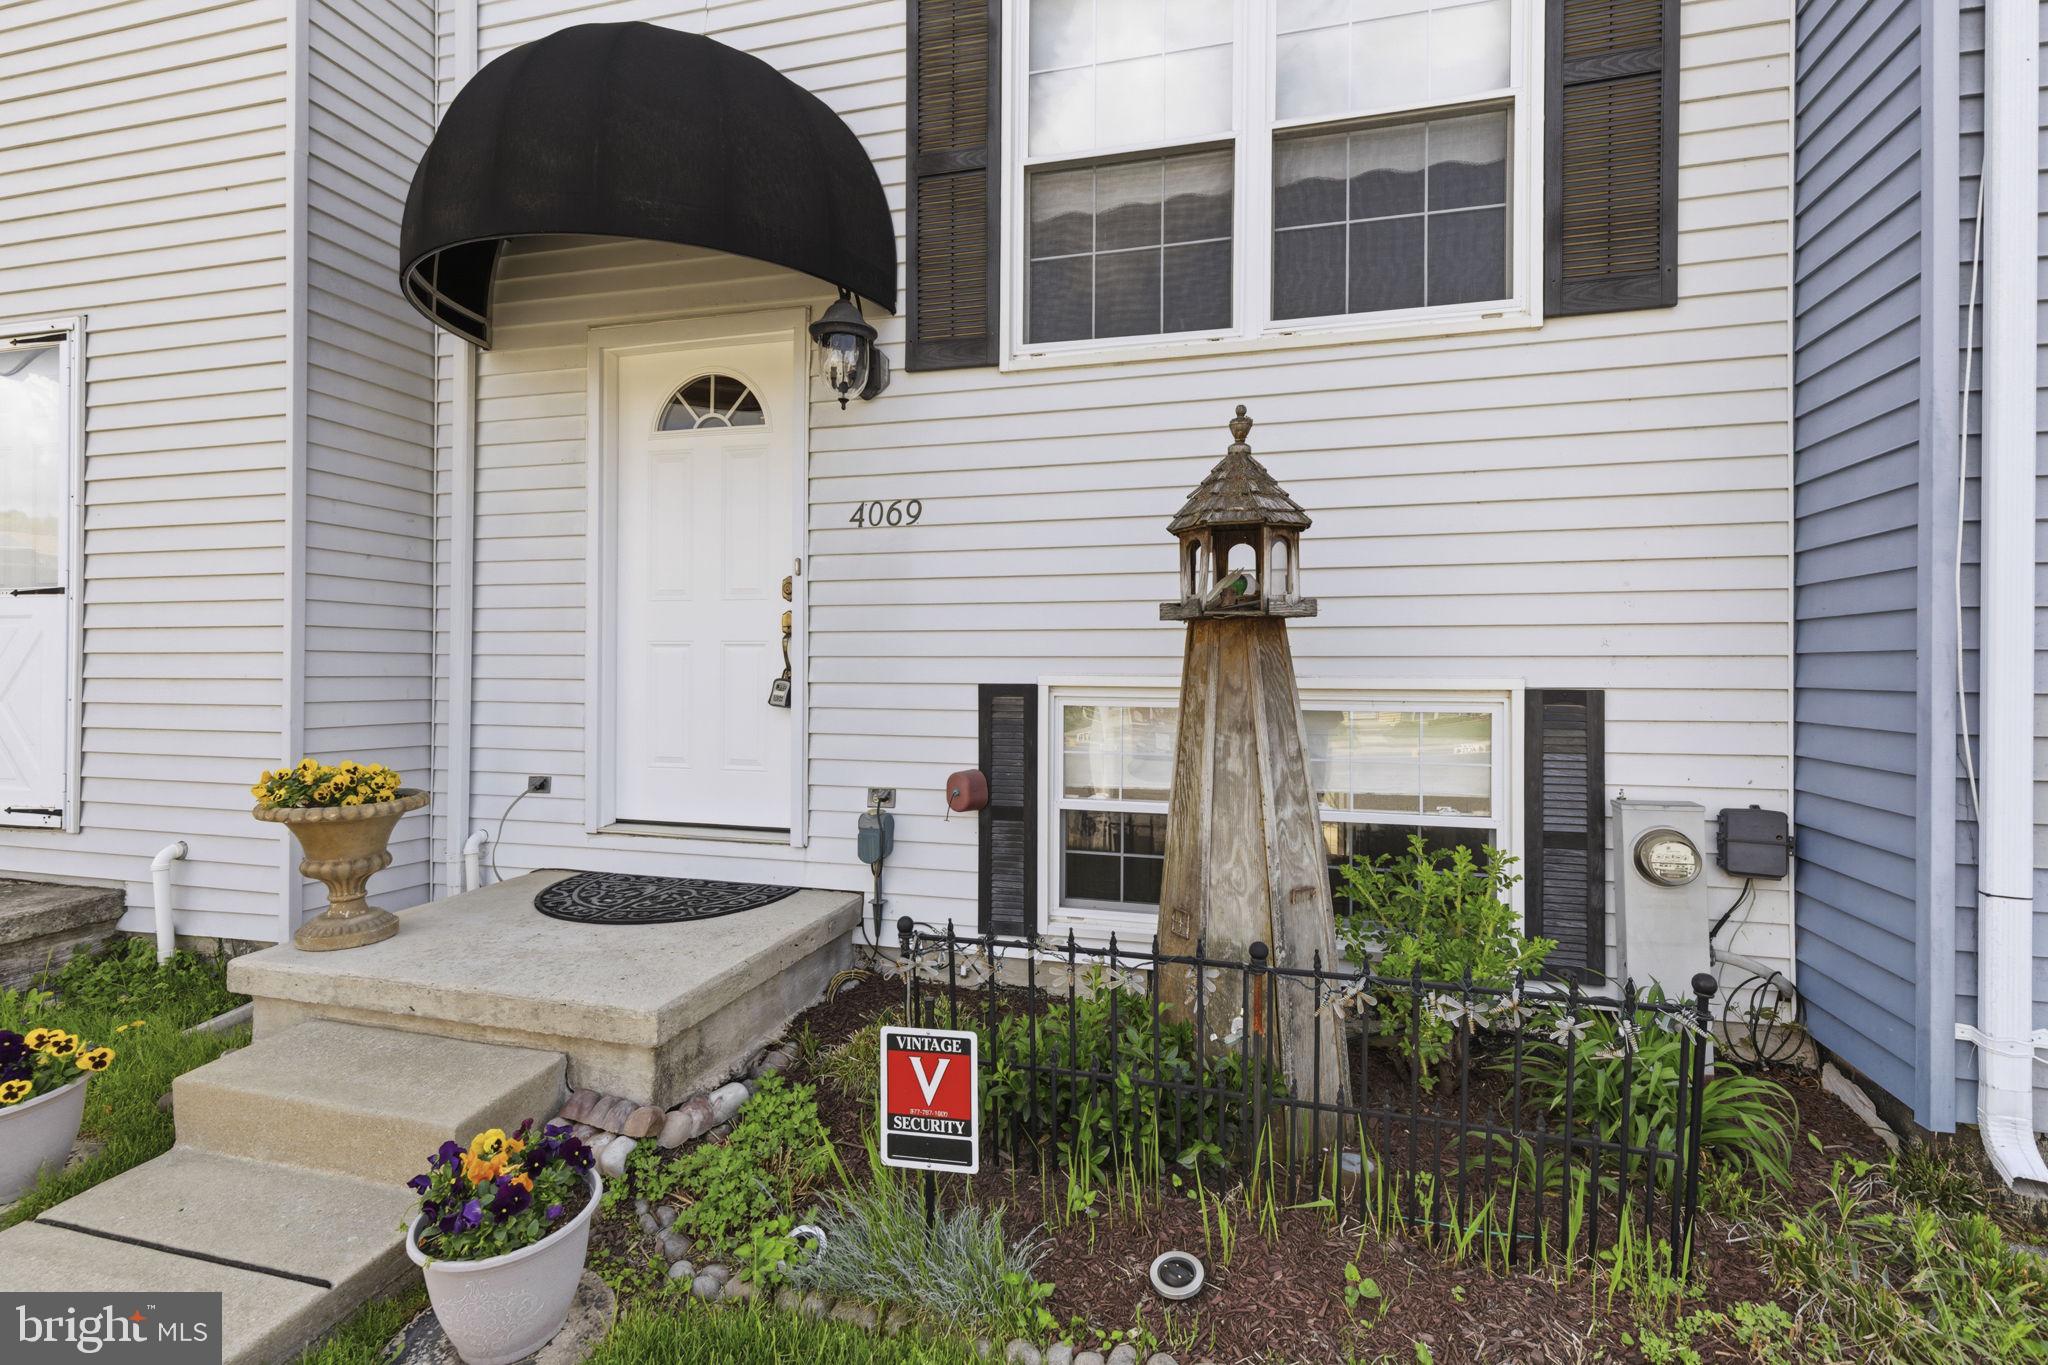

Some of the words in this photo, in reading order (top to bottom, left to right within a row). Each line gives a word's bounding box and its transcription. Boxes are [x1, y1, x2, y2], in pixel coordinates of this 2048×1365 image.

[848, 500, 923, 528] 4069
[896, 1036, 962, 1053] VINTAGE
[909, 1056, 951, 1107] V
[893, 1116, 965, 1134] SECURITY
